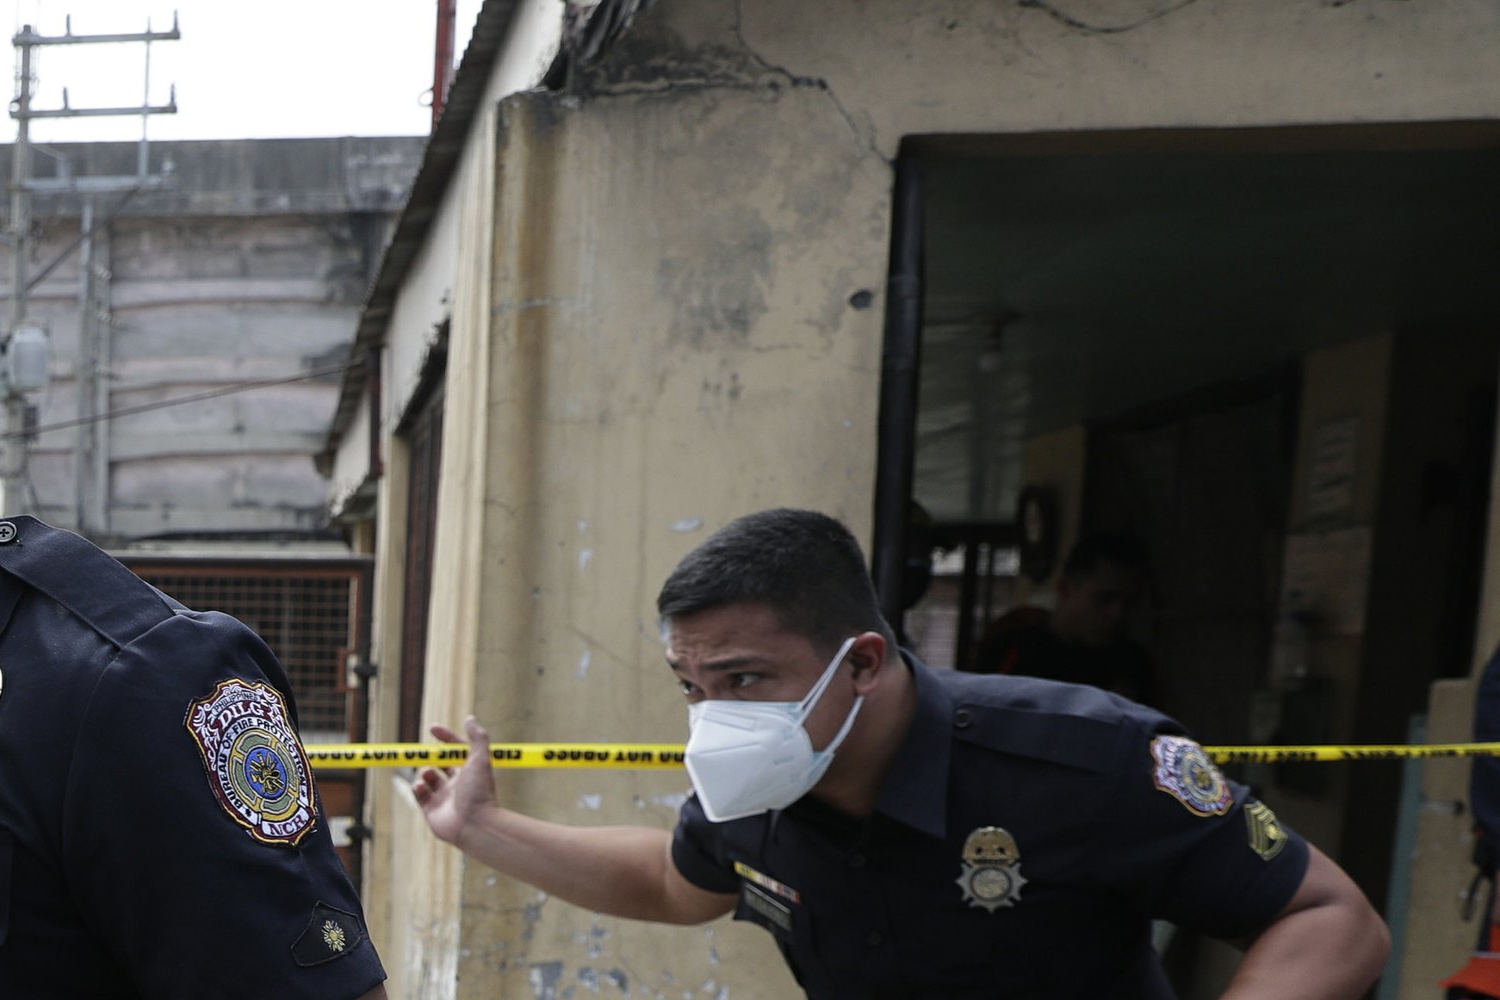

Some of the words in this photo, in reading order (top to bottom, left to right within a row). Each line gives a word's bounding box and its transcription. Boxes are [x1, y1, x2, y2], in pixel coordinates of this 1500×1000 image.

[213, 692, 259, 714] PHILIPPINES
[218, 702, 264, 730] DILG
[233, 717, 255, 735] FIRE
[224, 733, 235, 750] OF
[256, 719, 308, 788] PROTECTION
[219, 754, 244, 810] BUREAU
[268, 814, 307, 836] NCR
